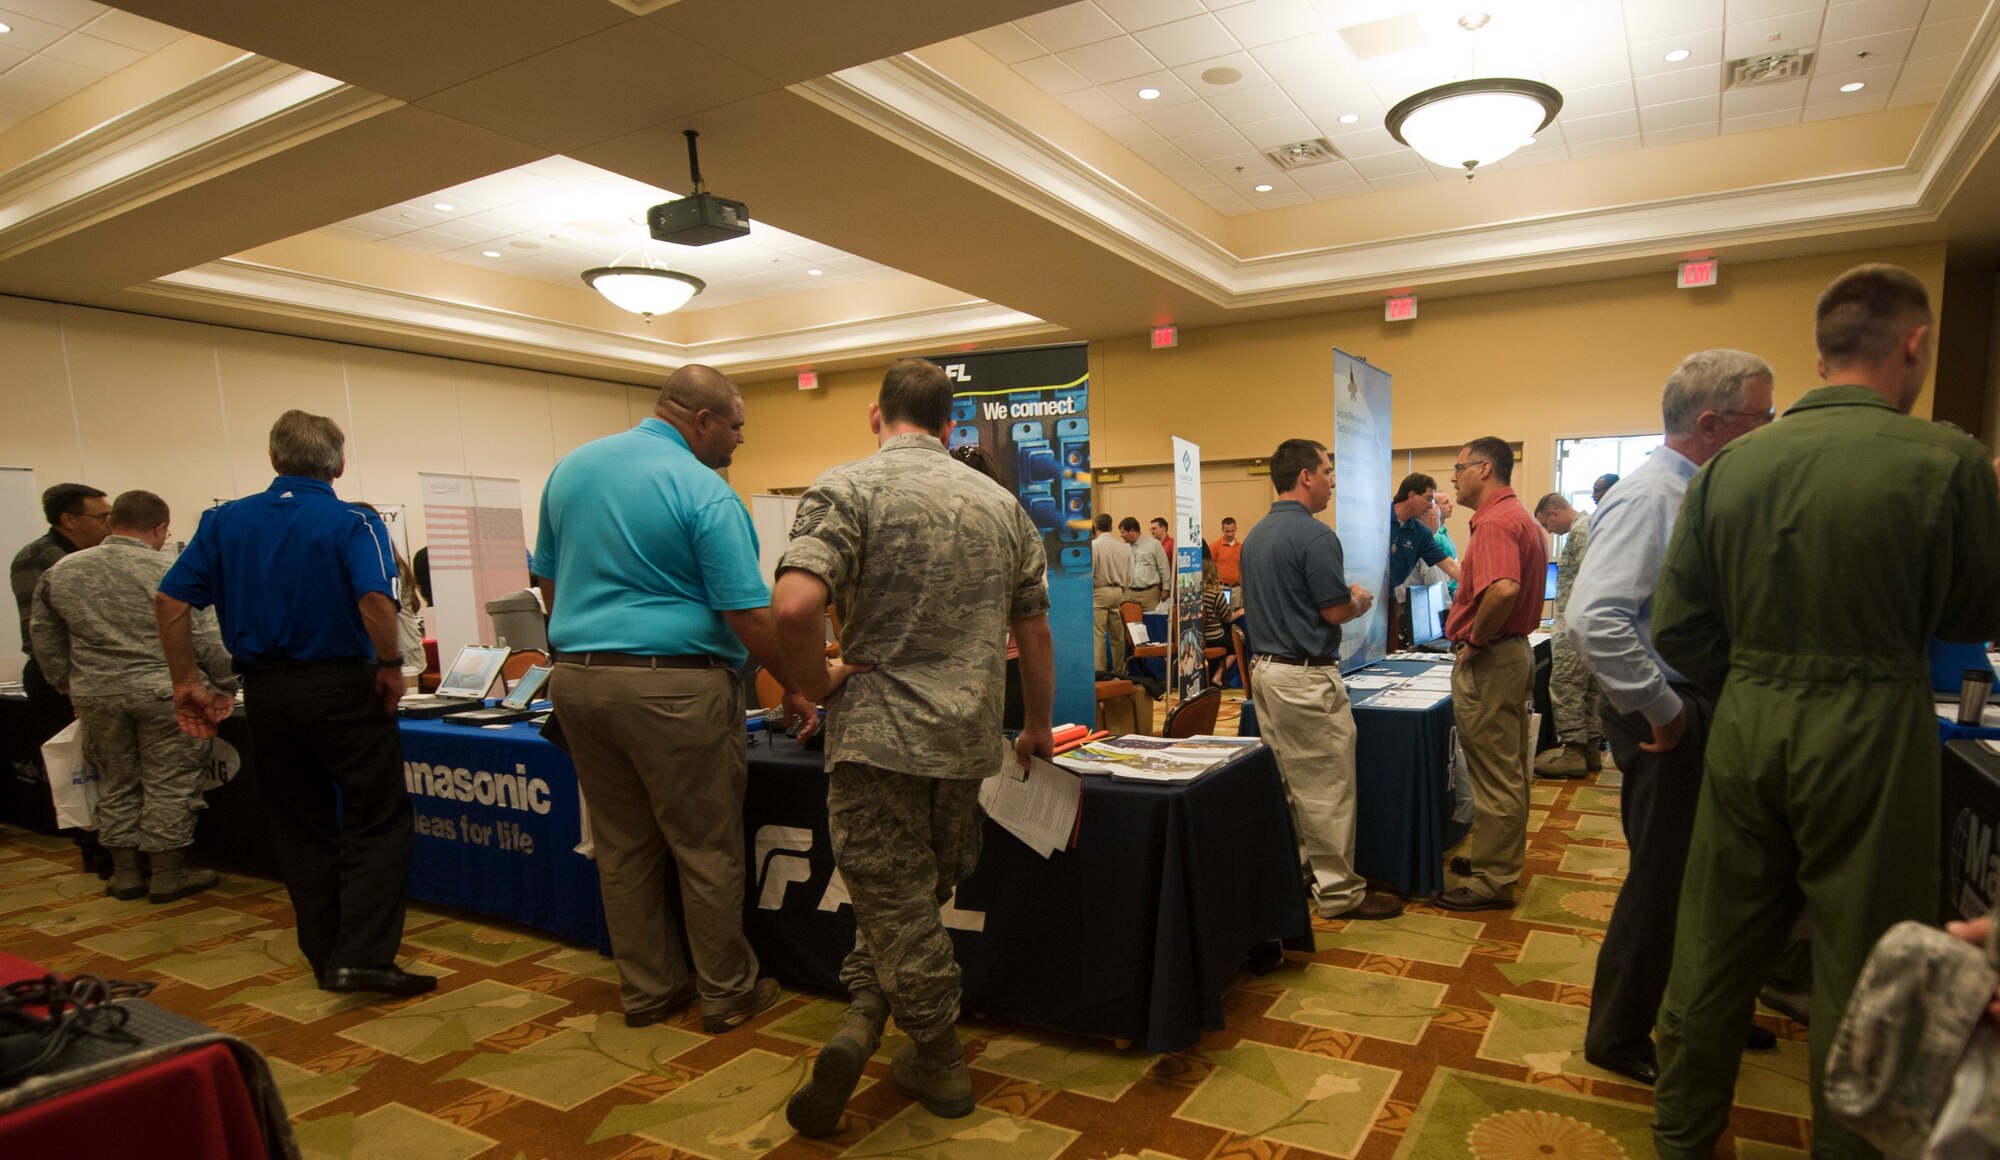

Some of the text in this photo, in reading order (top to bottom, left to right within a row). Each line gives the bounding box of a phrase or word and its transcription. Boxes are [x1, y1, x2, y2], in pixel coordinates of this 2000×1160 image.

[1685, 262, 1712, 284] EXIT
[1390, 299, 1412, 318] EXIT
[1155, 329, 1172, 346] EXIT
[943, 363, 971, 382] FL
[983, 402, 1007, 420] We
[460, 815, 493, 846] for
[497, 821, 534, 855] life
